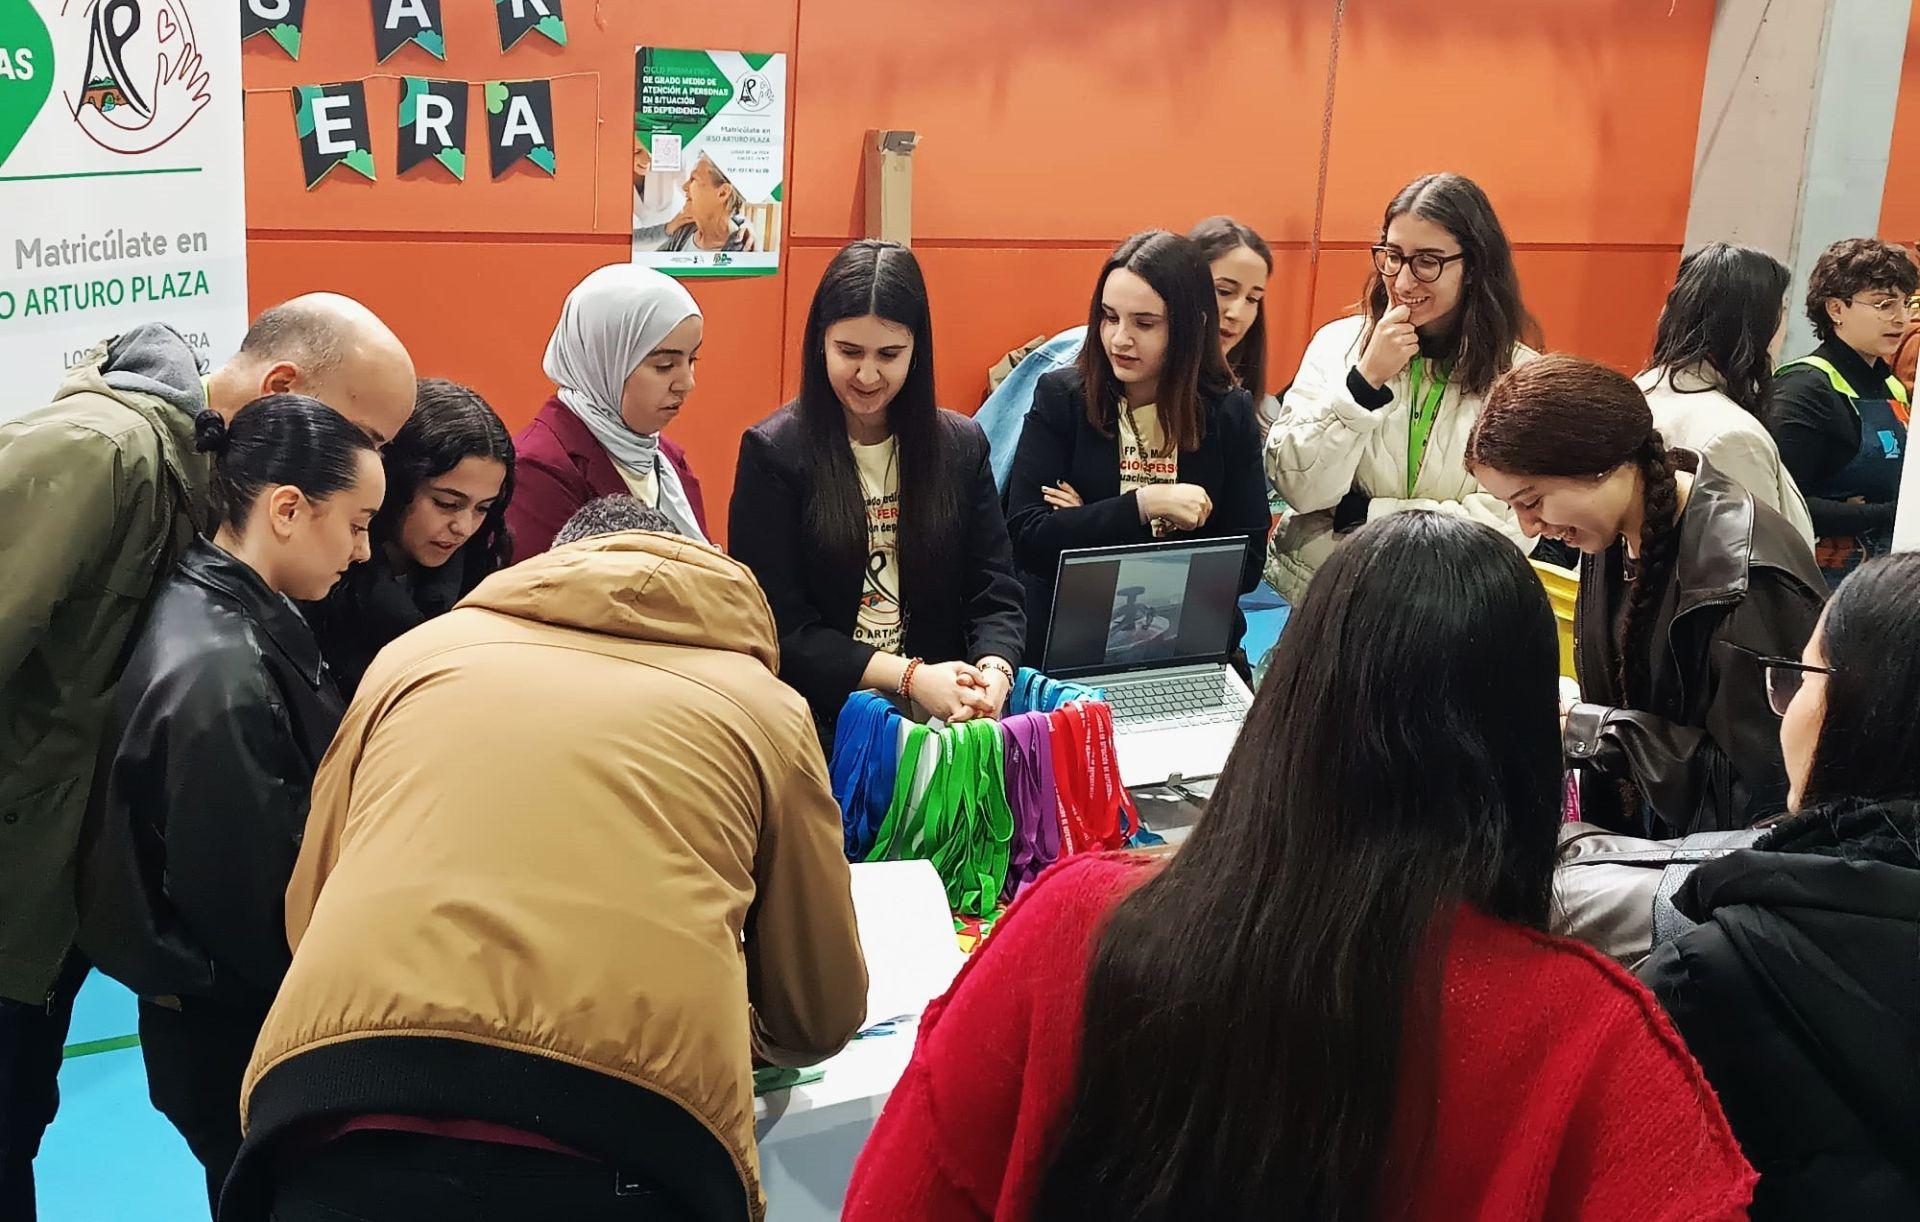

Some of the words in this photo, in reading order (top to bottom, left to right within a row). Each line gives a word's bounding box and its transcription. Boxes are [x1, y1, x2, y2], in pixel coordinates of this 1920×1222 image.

[643, 76, 653, 84] DE
[655, 76, 681, 84] GRADO
[682, 77, 706, 86] MEDIO
[707, 78, 717, 86] DE
[689, 87, 729, 96] PERSONAS
[643, 96, 653, 104] EN
[654, 96, 695, 105] SITUACIÓN
[643, 106, 653, 114] DE
[654, 106, 707, 115] DEPENDENCIA
[15, 228, 167, 270] Matricúlate
[176, 231, 208, 253] en
[24, 278, 124, 317] ARTURO
[132, 270, 209, 303] PLAZA
